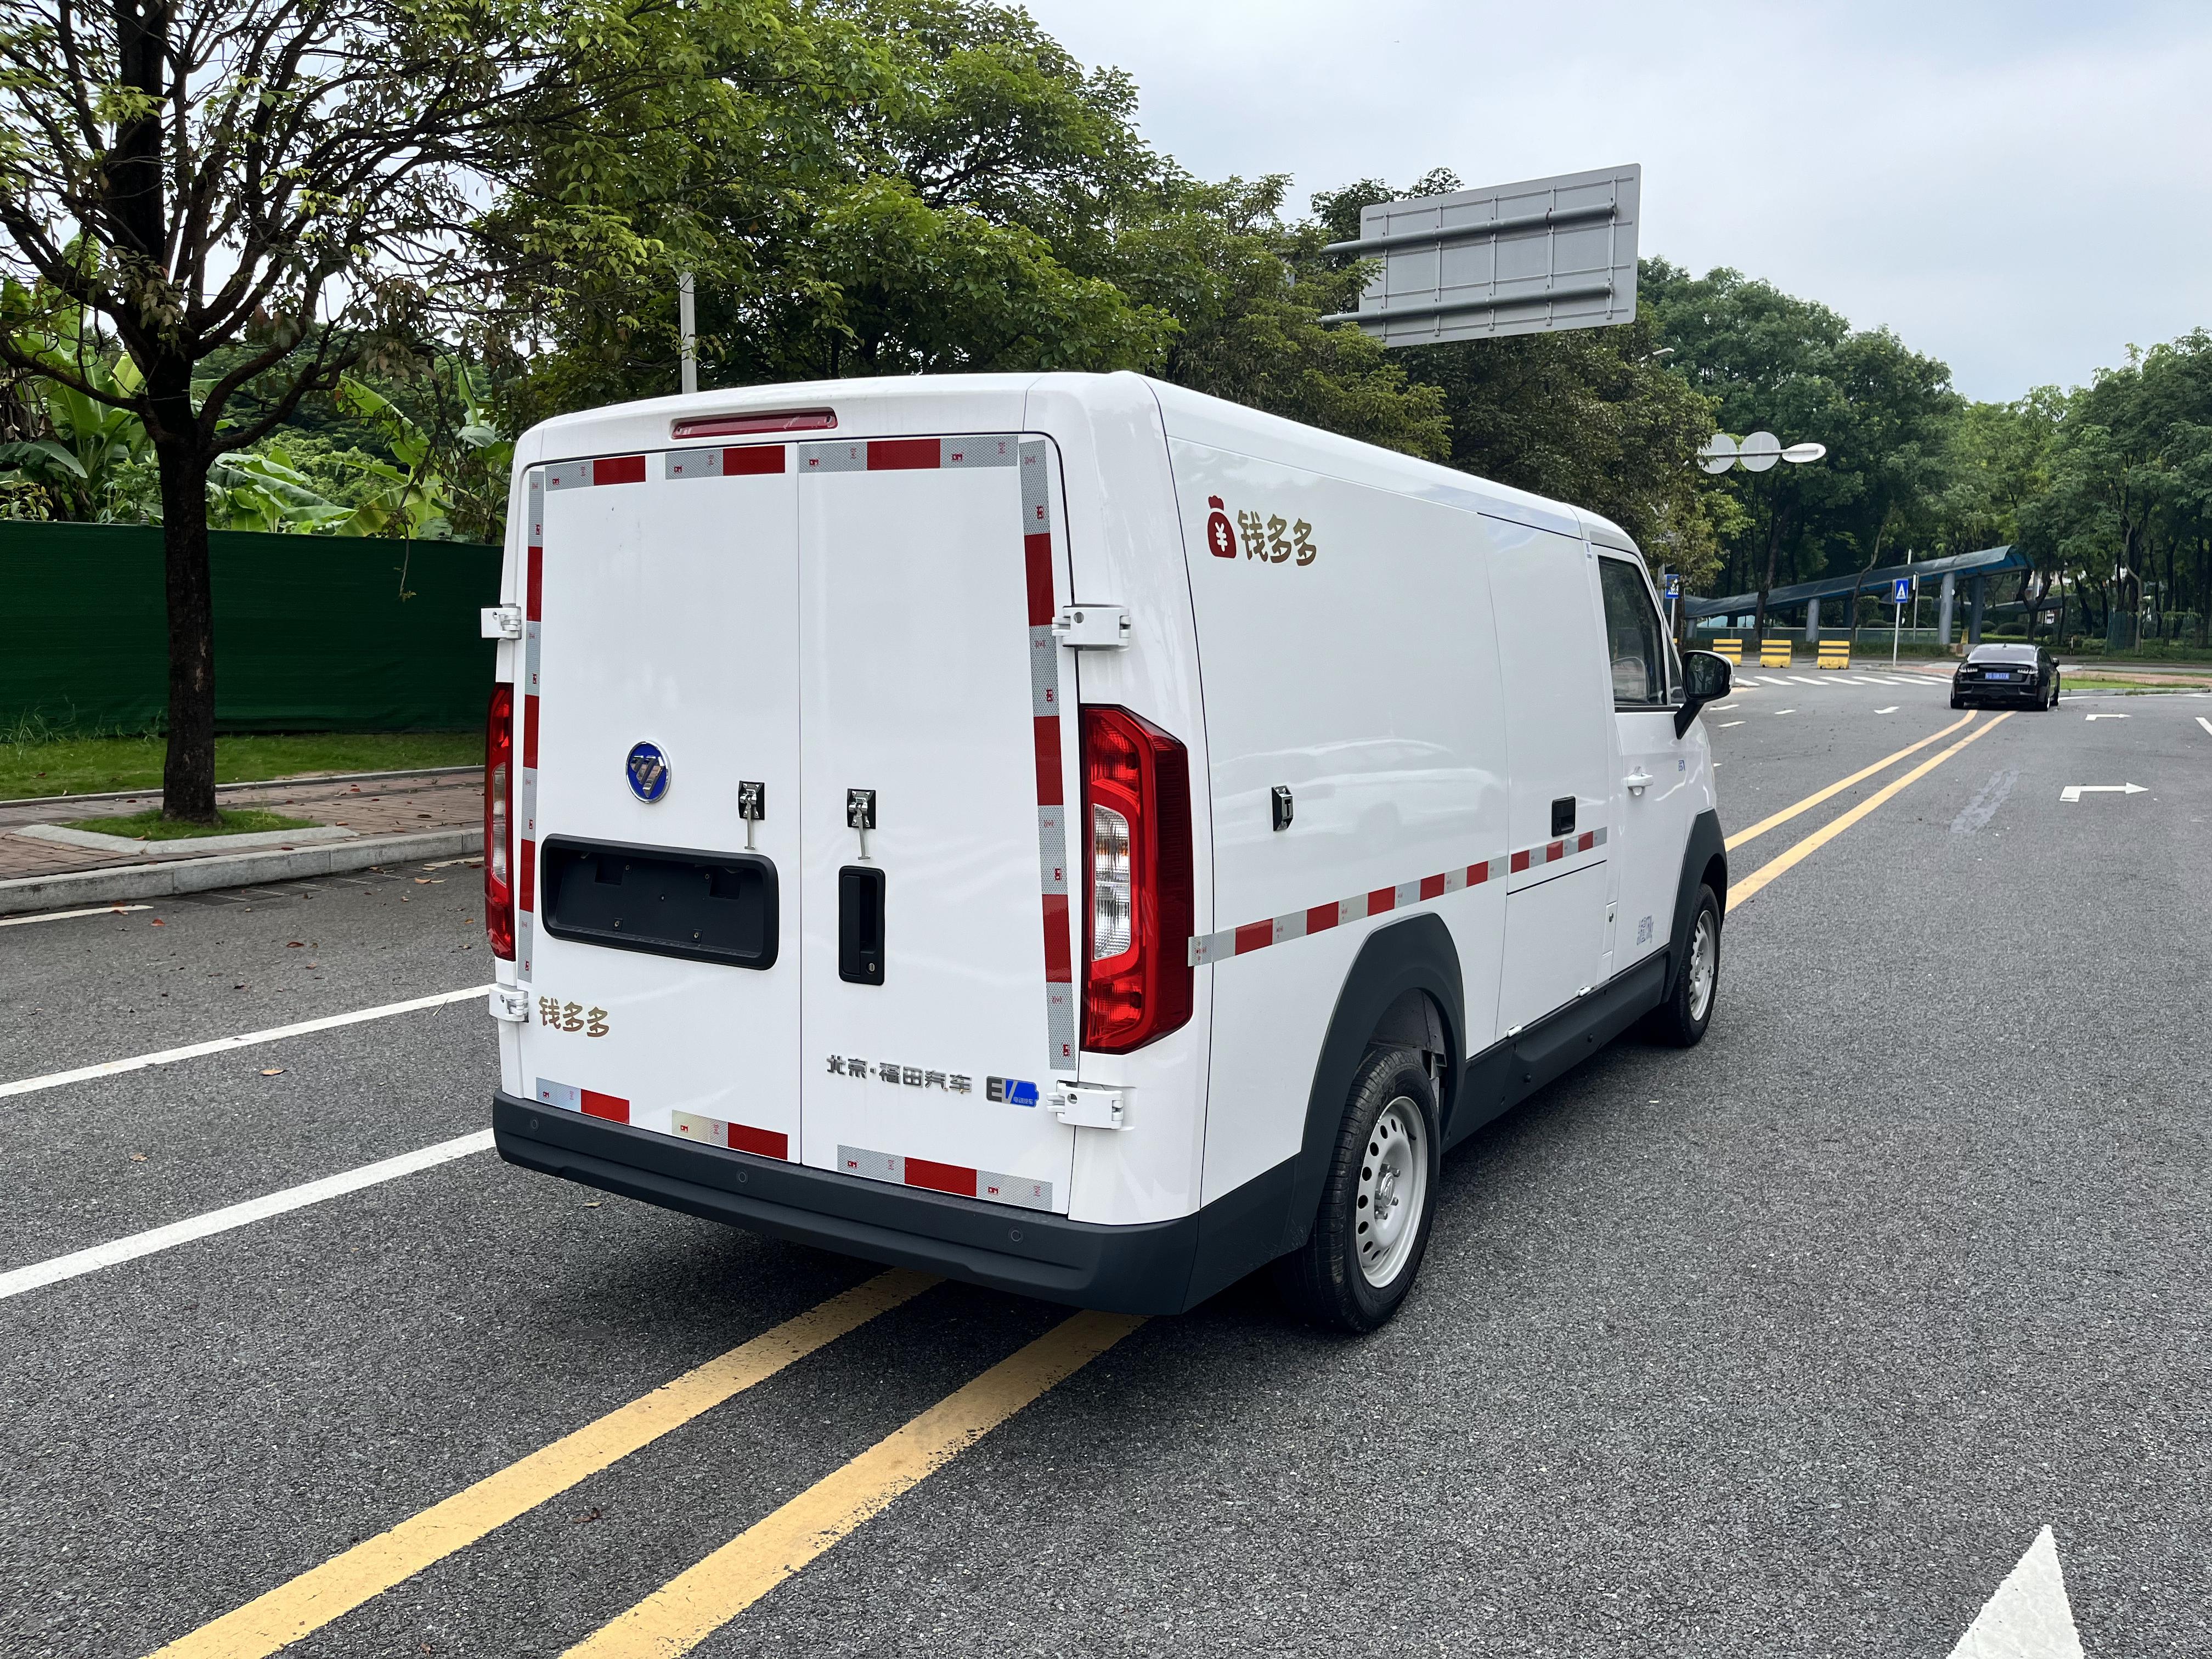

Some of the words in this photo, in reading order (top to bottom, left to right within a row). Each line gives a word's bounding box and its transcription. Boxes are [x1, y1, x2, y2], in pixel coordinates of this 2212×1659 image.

[1237, 509, 1317, 567] 钱多多
[538, 995, 610, 1038] 钱多多
[680, 1125, 689, 1133] DM
